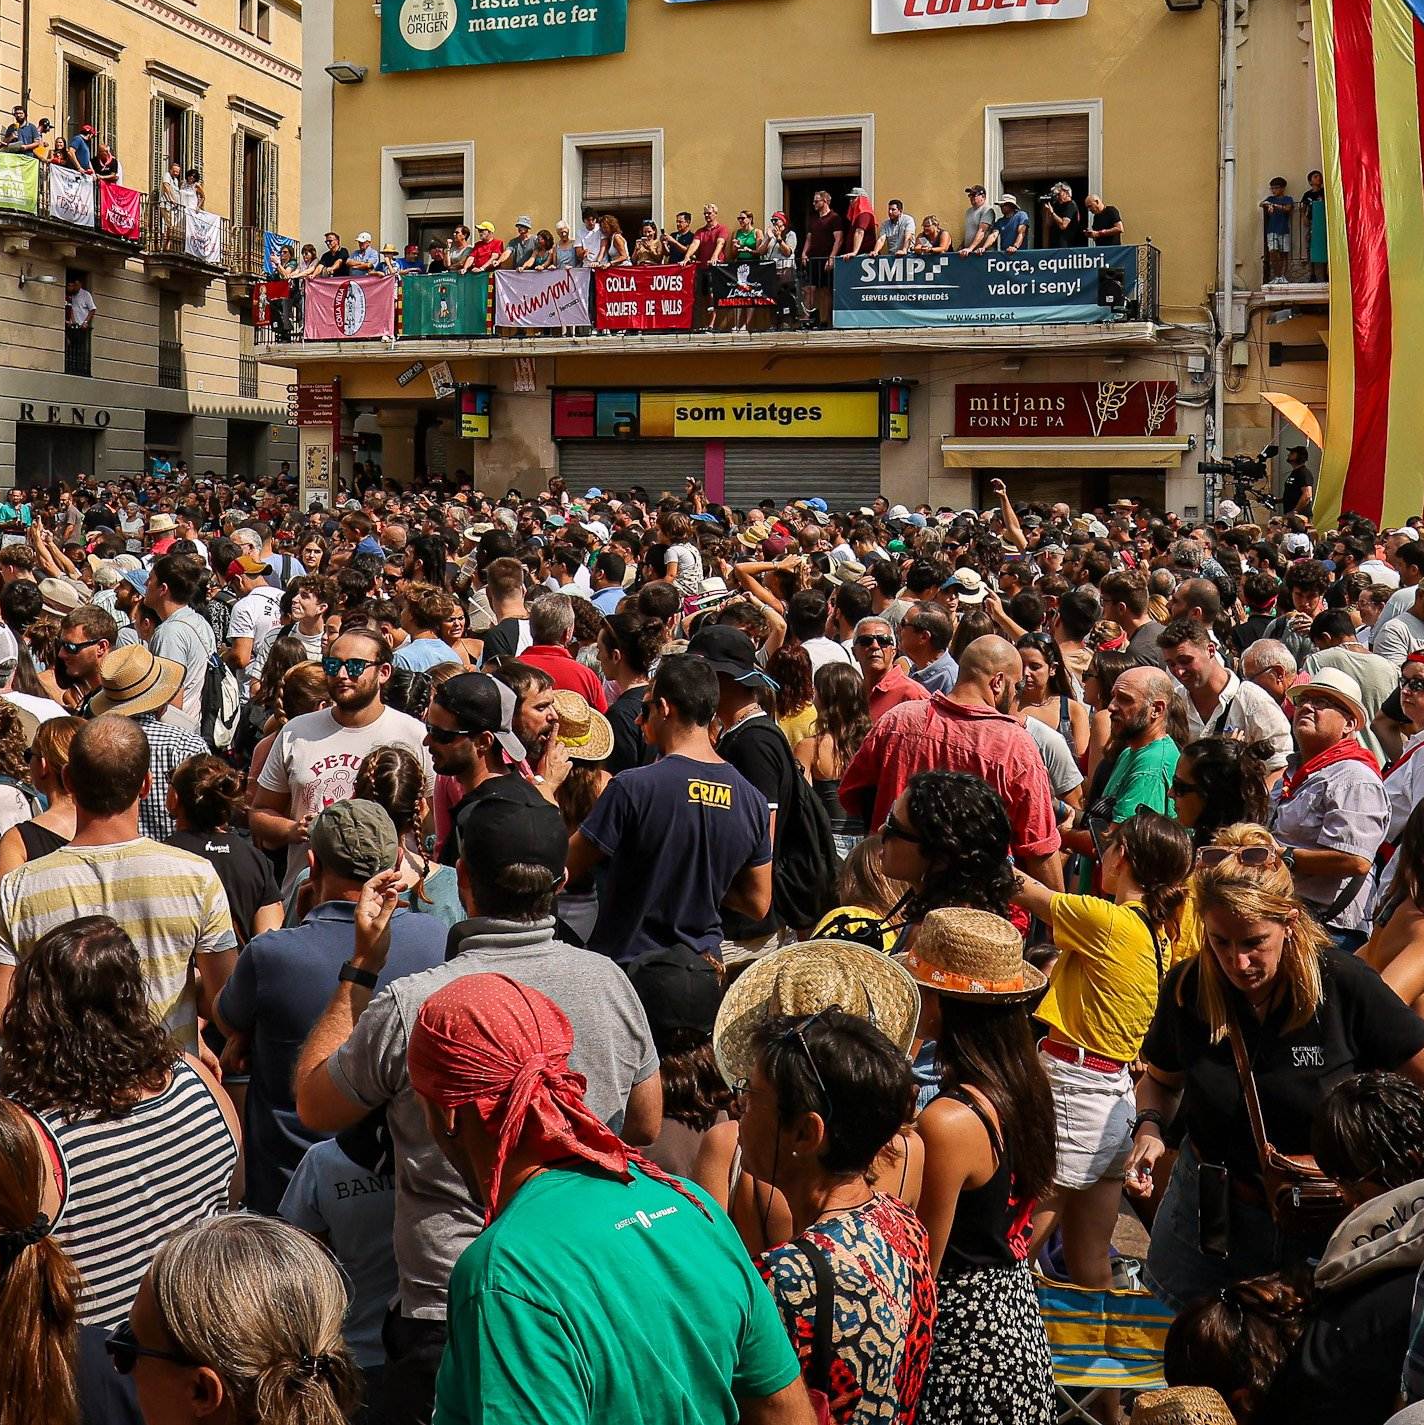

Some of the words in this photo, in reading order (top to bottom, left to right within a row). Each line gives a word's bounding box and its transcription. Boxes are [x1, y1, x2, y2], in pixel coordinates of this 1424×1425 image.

[407, 11, 448, 24] AMETLLER
[468, 14, 539, 33] manera
[544, 8, 566, 26] de
[570, 5, 598, 23] fer
[407, 20, 448, 35] ORIGEN
[860, 258, 925, 282] SMP
[987, 258, 1035, 276] Força,
[606, 276, 636, 293] COLLA
[650, 275, 683, 291] JOVES
[987, 280, 1027, 296] valor
[1031, 280, 1036, 294] i
[1039, 280, 1082, 298] seny!
[336, 288, 345, 306] VELLA
[861, 294, 887, 302] SERVEIS
[889, 293, 916, 302] MÈDICS
[918, 292, 949, 302] PENEDÈS
[335, 304, 344, 327] COLLA
[606, 300, 638, 316] XIQUETS
[646, 300, 656, 316] DE
[661, 299, 683, 315] VALLS
[946, 311, 1016, 321] www.smp.cat
[969, 392, 1065, 415] mitjans
[19, 402, 111, 428] RENO
[676, 406, 726, 421] som
[732, 403, 822, 426] viatges
[970, 416, 1011, 426] FORN
[1019, 416, 1038, 426] DE
[1046, 416, 1064, 426] PA
[689, 782, 731, 806] CRIM
